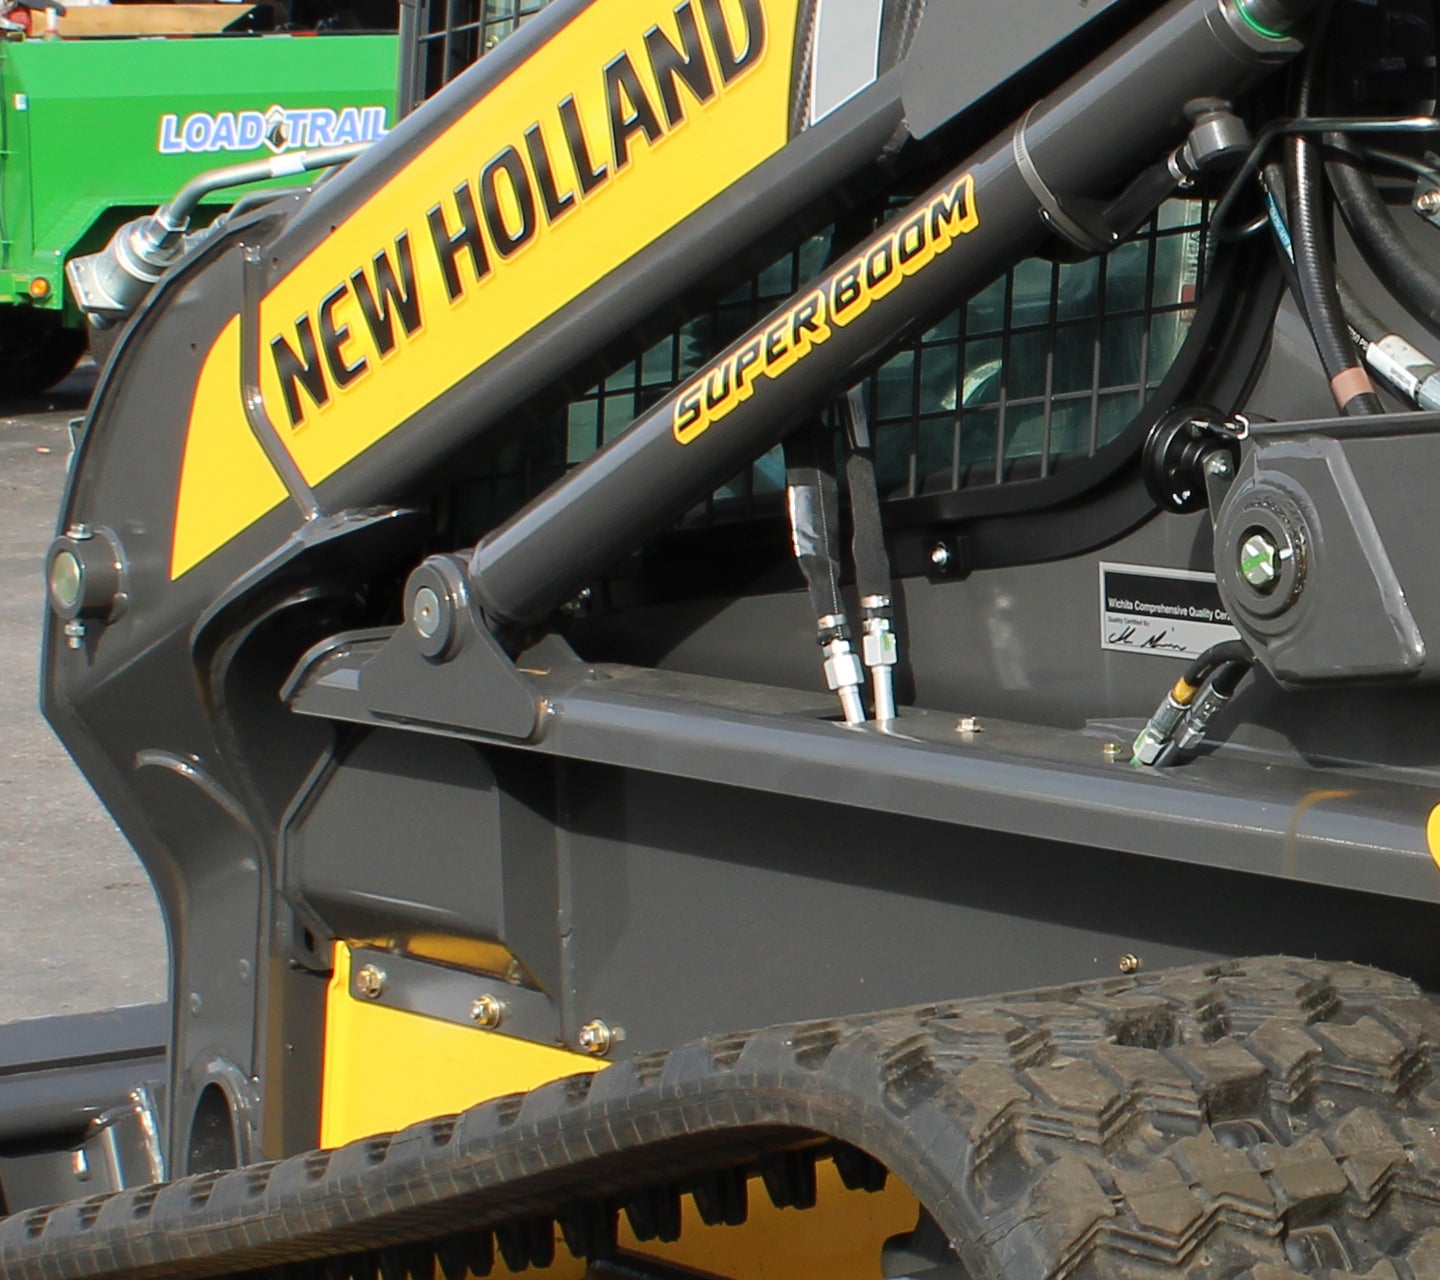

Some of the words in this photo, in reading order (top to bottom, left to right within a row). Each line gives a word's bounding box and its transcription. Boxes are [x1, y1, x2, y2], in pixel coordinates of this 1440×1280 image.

[159, 111, 267, 154] LOAD
[284, 106, 392, 148] TRAIL
[268, 227, 428, 433] NEW
[674, 300, 830, 445] SUPER
[828, 175, 978, 324] BOOM
[1108, 597, 1134, 611] Wichita
[1134, 600, 1188, 617] Comprehensive
[1189, 606, 1213, 621] Quality
